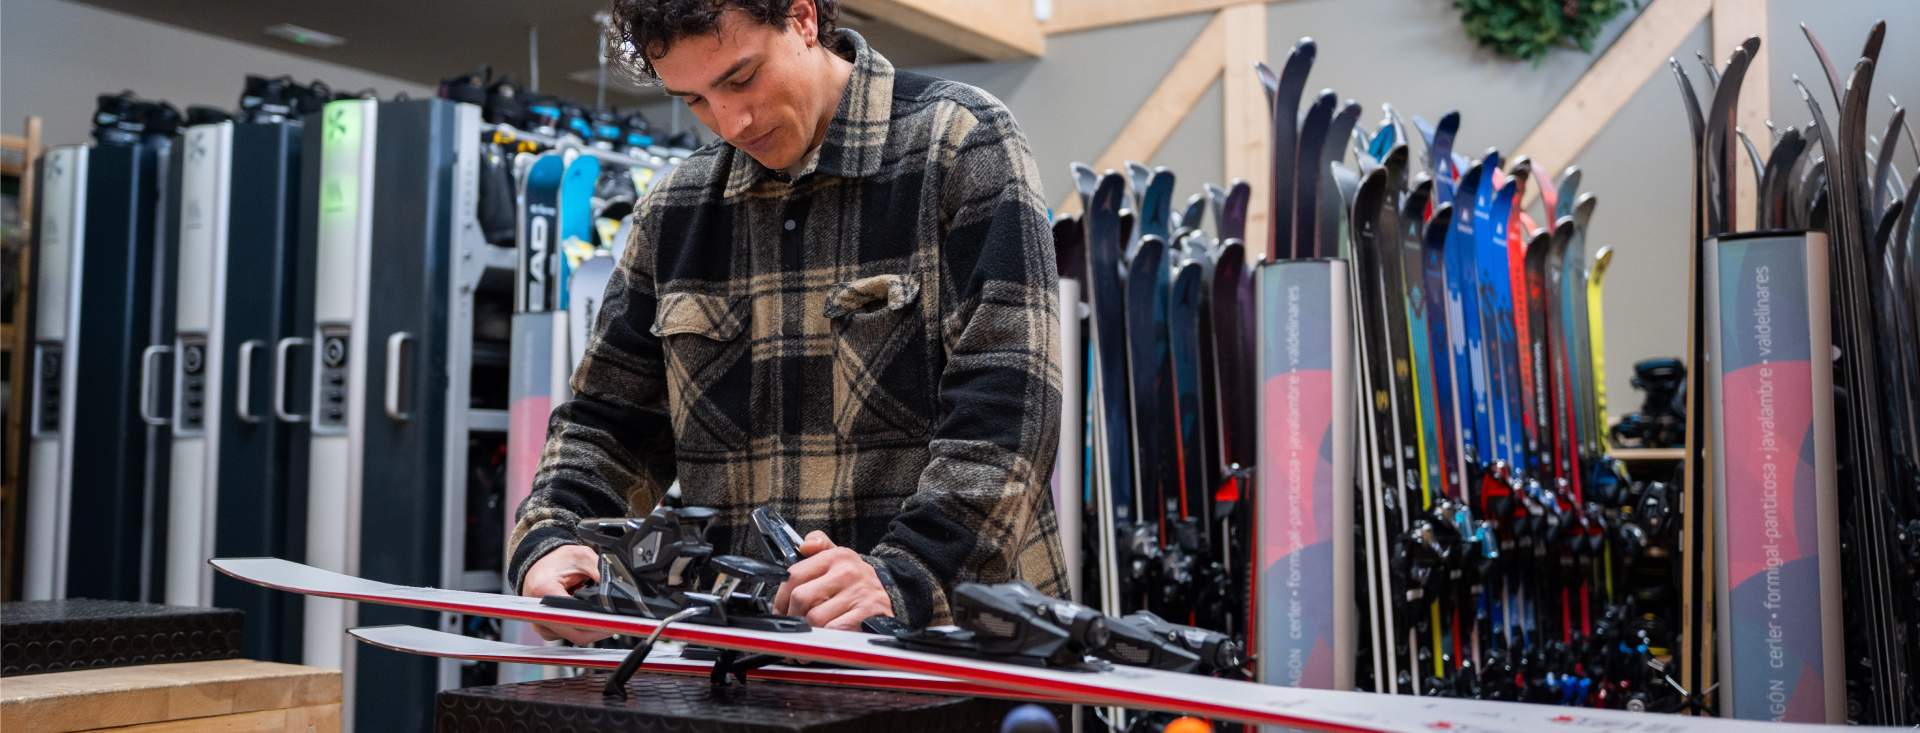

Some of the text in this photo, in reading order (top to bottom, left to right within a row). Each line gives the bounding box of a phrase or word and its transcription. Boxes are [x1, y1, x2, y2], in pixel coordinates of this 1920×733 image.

[529, 216, 548, 312] EAD
[1285, 286, 1303, 687] AGÓN cerler formigal-panticosa javalambre valdelinares
[1754, 266, 1784, 723] AGÓN cerler formigal-panticosa javalambre valdelinares
